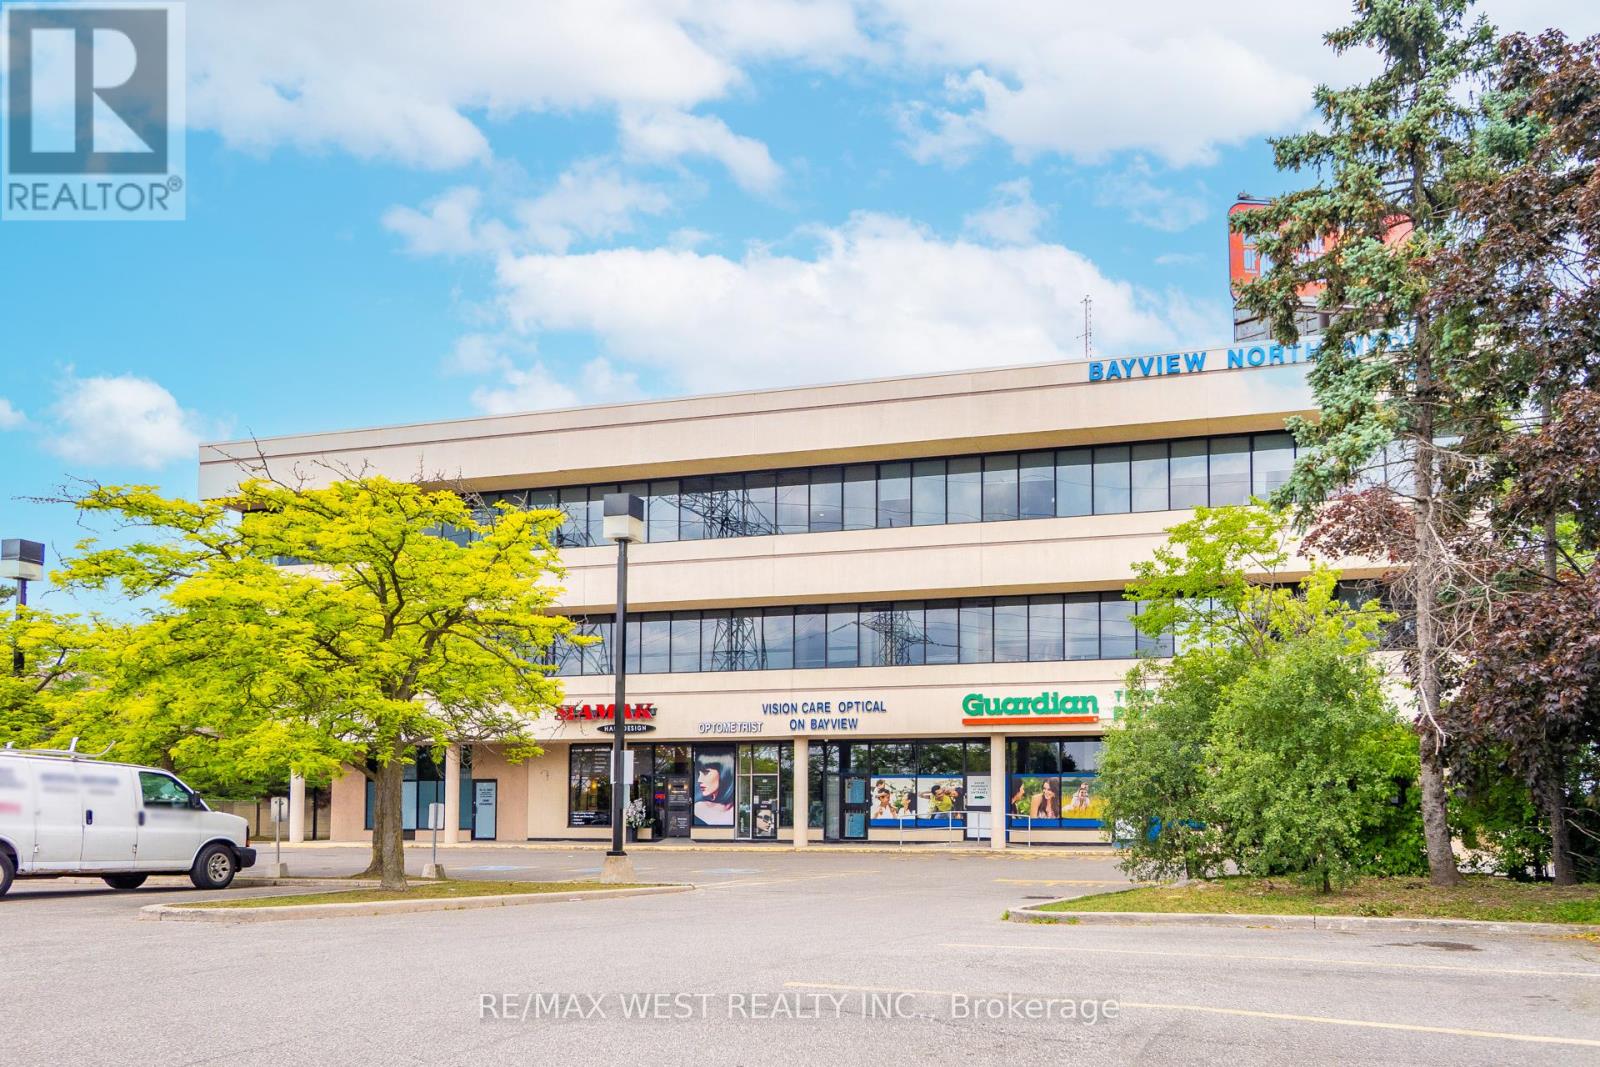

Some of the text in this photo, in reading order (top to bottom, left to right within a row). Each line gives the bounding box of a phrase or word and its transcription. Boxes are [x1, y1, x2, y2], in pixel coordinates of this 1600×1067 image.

[1089, 351, 1207, 382] BAYVIEW
[762, 700, 887, 715] VISION CARE OPTICAL
[962, 692, 1099, 716] Guardian
[698, 721, 763, 734] OPTOMETRIST
[789, 718, 859, 731] ON BAYVIEW
